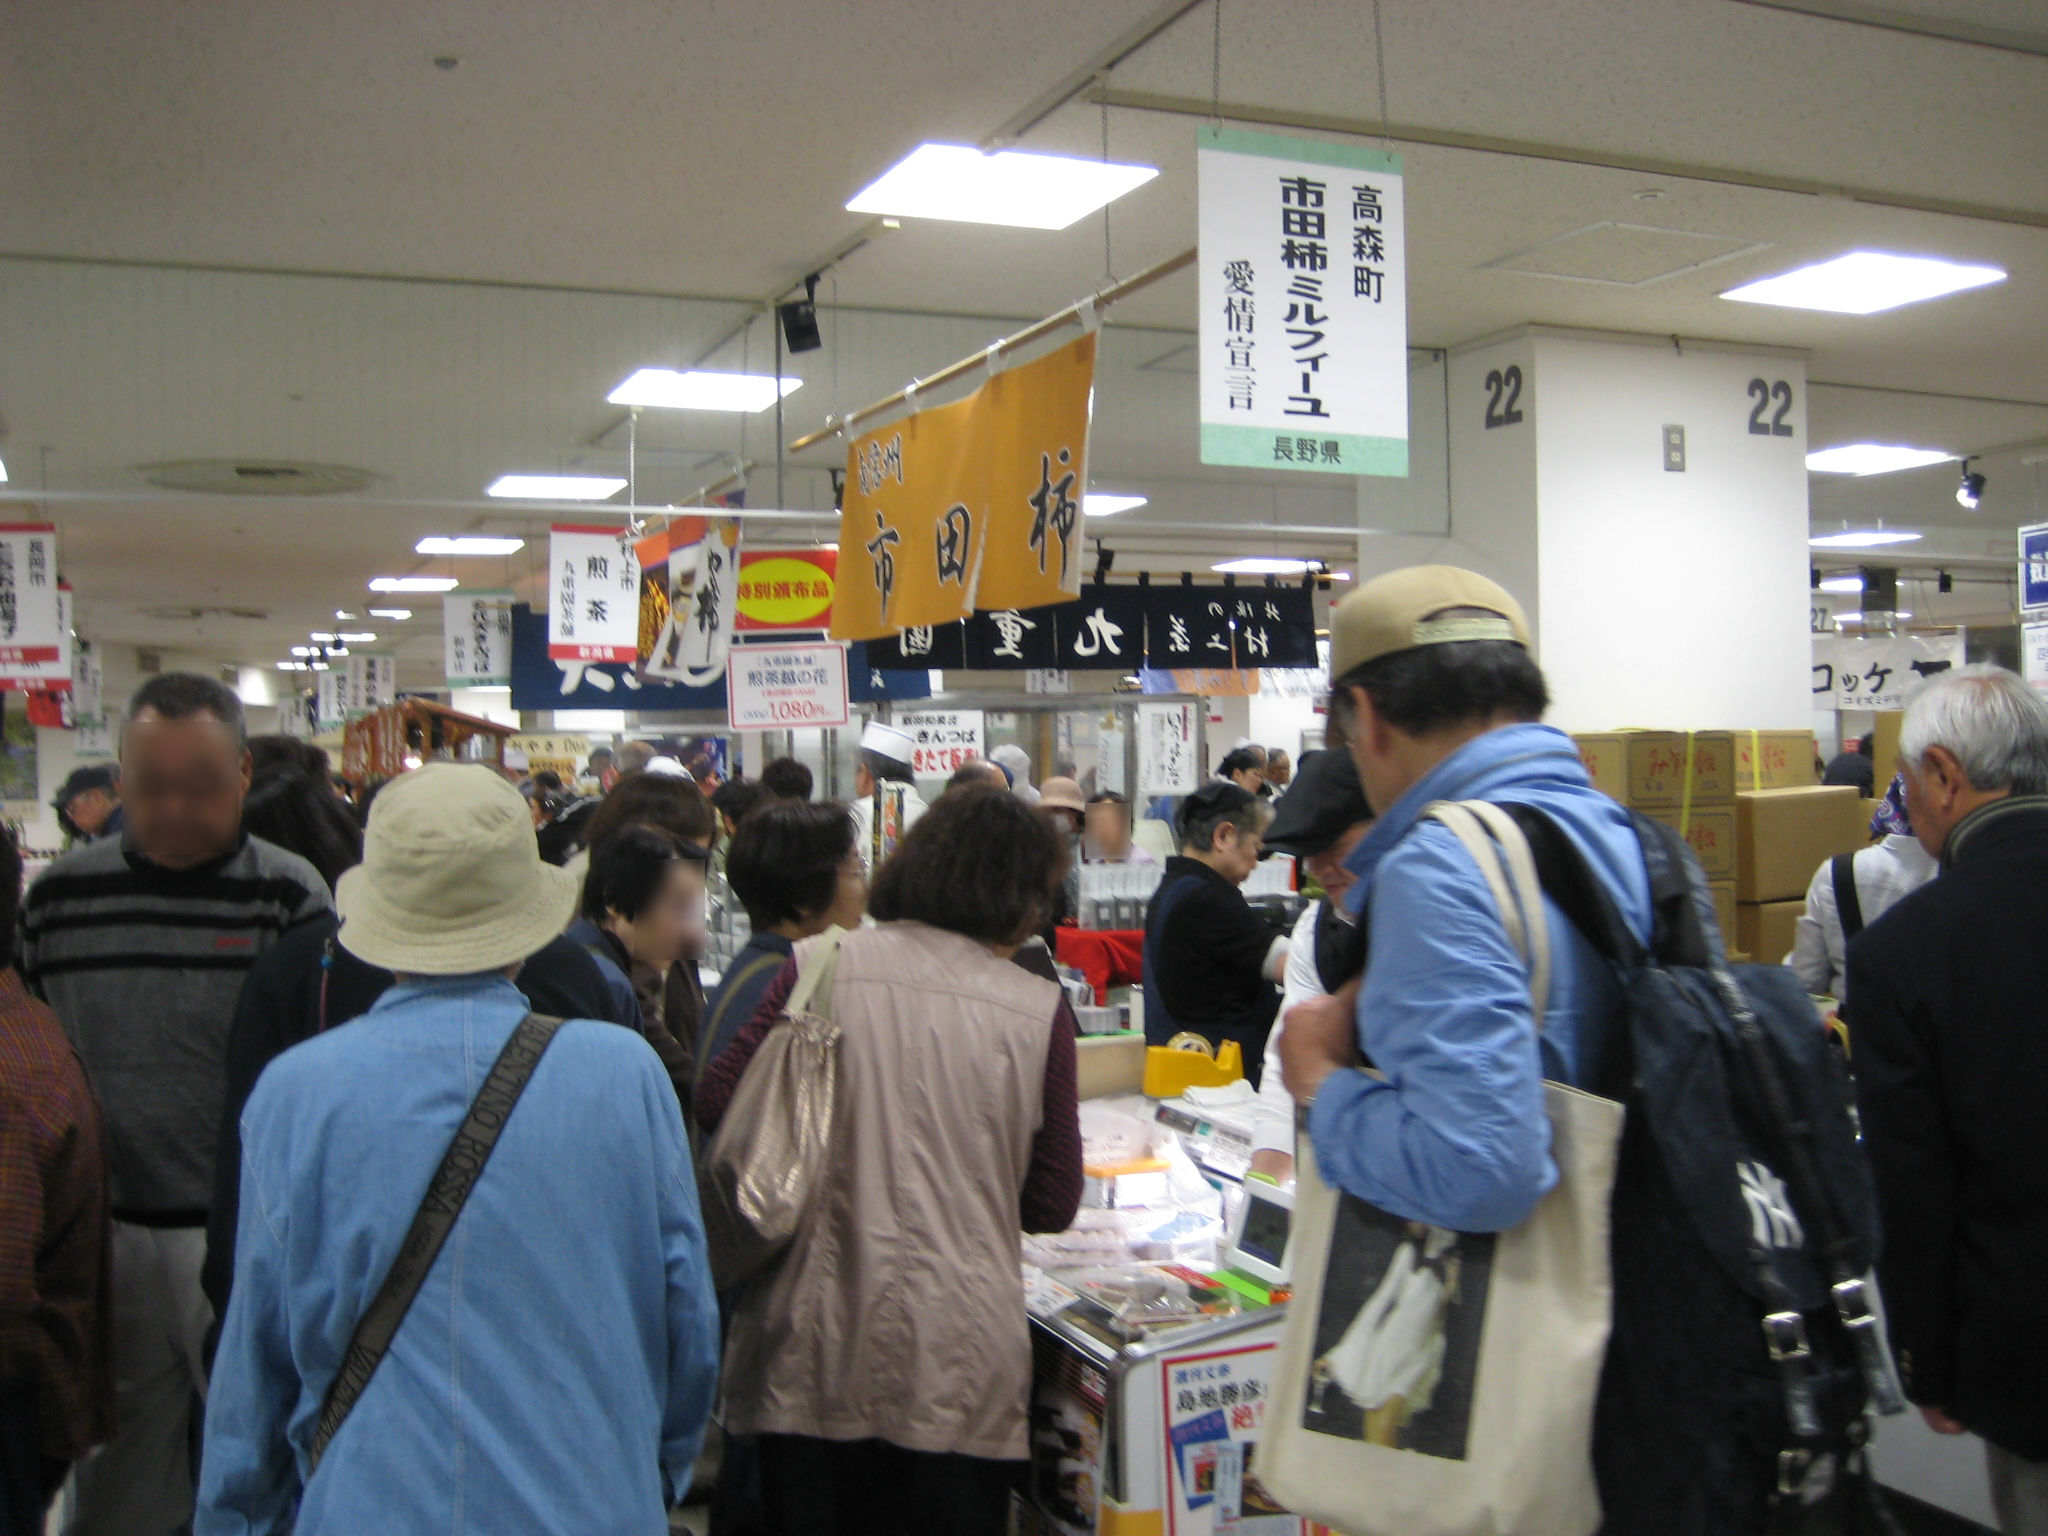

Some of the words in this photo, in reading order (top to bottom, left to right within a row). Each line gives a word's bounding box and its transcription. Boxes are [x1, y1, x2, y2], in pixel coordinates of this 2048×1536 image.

[1350, 184, 1385, 305] 高森町
[1279, 175, 1331, 418] 市田柿ミルフィーユ
[1222, 259, 1257, 411] 愛情宣言
[1485, 365, 1523, 430] 22
[1747, 378, 1793, 438] 22
[1272, 436, 1342, 465] 長野県
[585, 553, 610, 624] 煎茶
